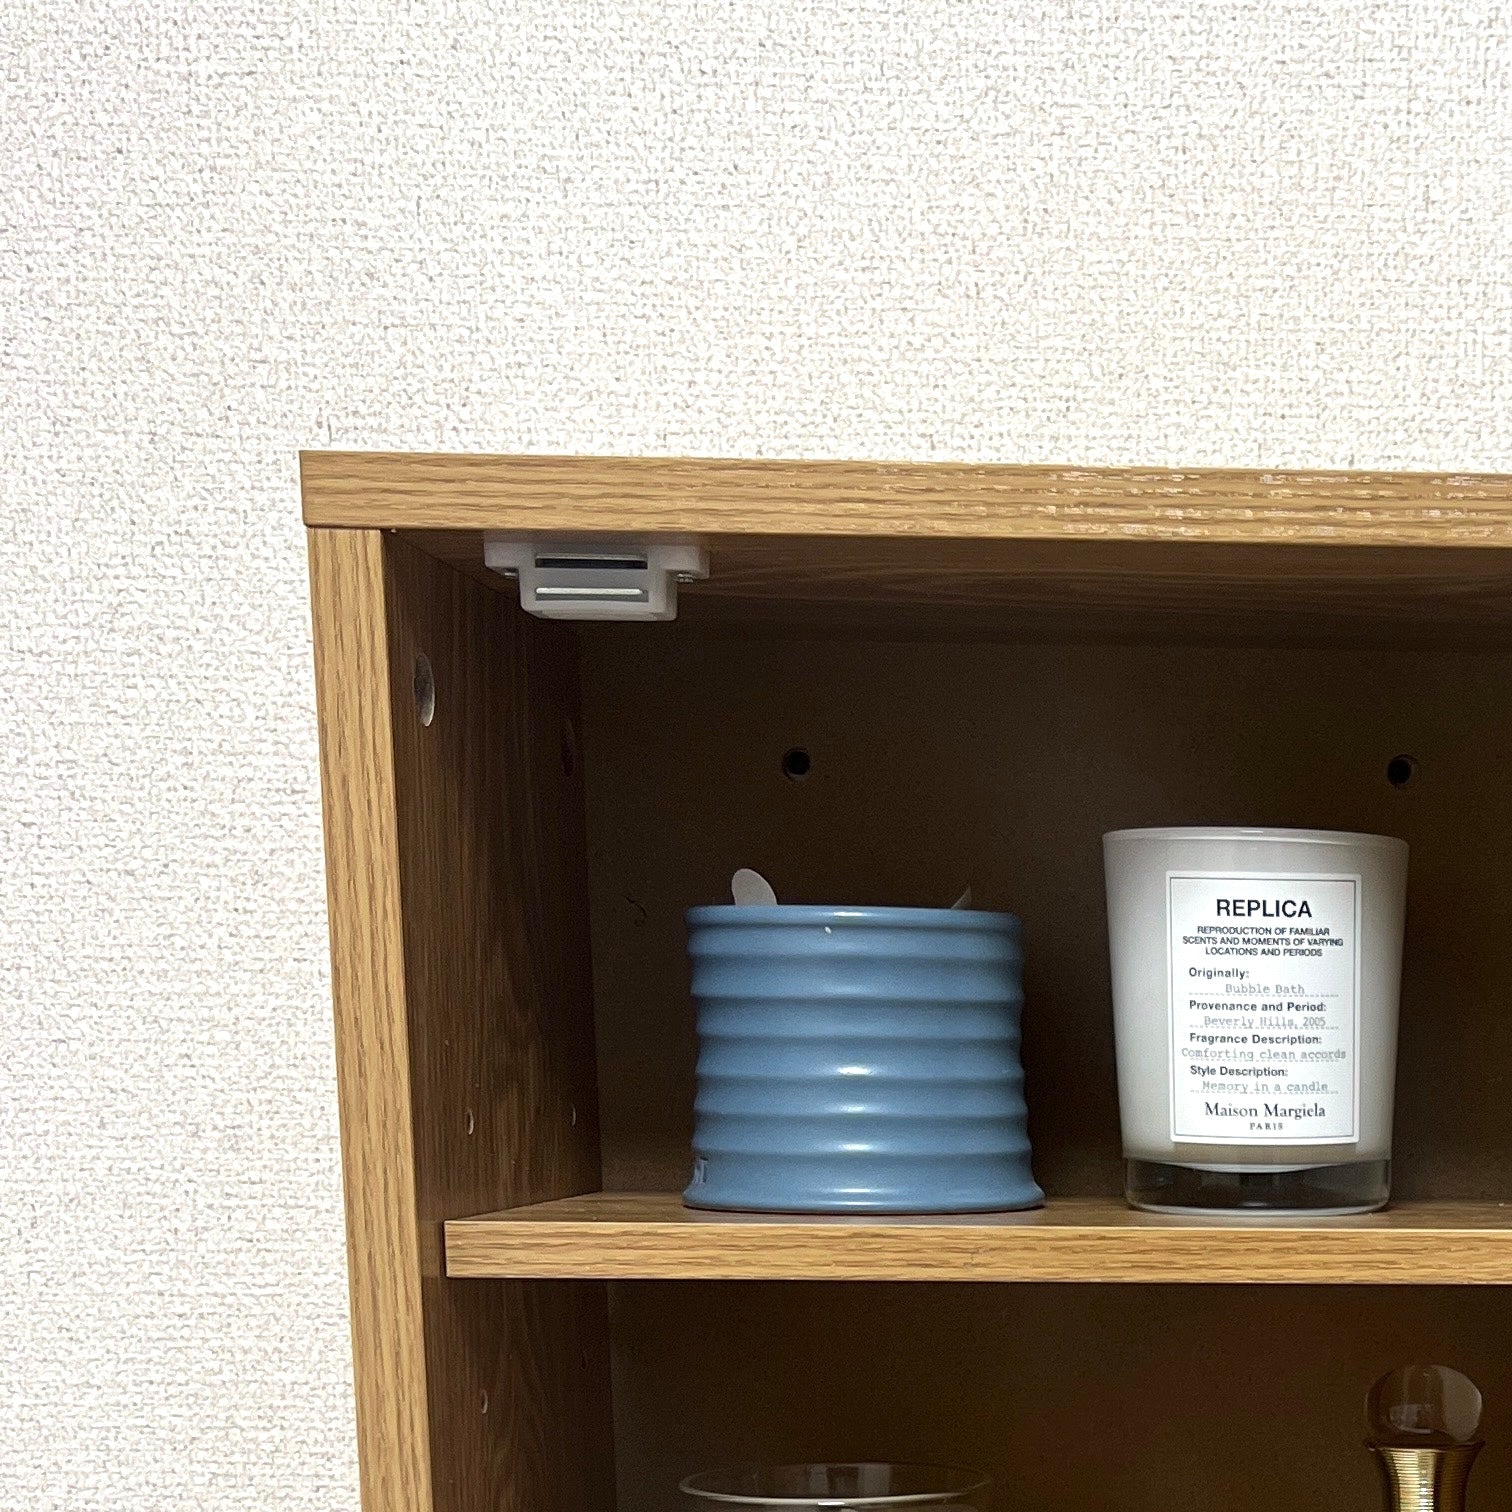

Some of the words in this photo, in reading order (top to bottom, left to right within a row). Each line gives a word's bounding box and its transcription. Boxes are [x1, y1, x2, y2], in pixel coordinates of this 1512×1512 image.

[1216, 898, 1313, 918] REPLICA
[1197, 925, 1272, 936] REPRODUCTION
[1274, 927, 1287, 936] OF
[1289, 927, 1330, 936] FAMILIAR
[1182, 935, 1218, 945] SCENTS
[1219, 937, 1240, 945] AND
[1242, 937, 1290, 946] MOMENTS
[1293, 938, 1305, 946] OF
[1307, 938, 1344, 947] VARYING
[1205, 946, 1258, 956] LOCATIONS
[1260, 947, 1281, 957] AND
[1283, 947, 1323, 957] PERIODS
[1188, 967, 1250, 980] Originally:
[1225, 983, 1271, 994] Bubble
[1275, 984, 1305, 995] Bath
[1189, 1000, 1257, 1011] Provenance
[1261, 1001, 1283, 1012] and
[1287, 1002, 1327, 1012] Period:
[1204, 1015, 1254, 1028] Beverly
[1302, 1016, 1327, 1027] 2005
[1189, 1032, 1248, 1045] Fragrance
[1252, 1034, 1322, 1045] Description:
[1181, 1047, 1254, 1061] Comforting
[1259, 1049, 1296, 1060] clean
[1300, 1048, 1347, 1060] accords
[1190, 1065, 1217, 1077] Style
[1219, 1066, 1288, 1078] Description:
[1202, 1080, 1249, 1094] Memory
[1254, 1081, 1269, 1092] in
[1274, 1083, 1281, 1092] a
[1286, 1081, 1329, 1092] candle
[1204, 1101, 1258, 1117] Maison
[1263, 1102, 1326, 1120] Margiela
[1249, 1122, 1284, 1131] PARIS
